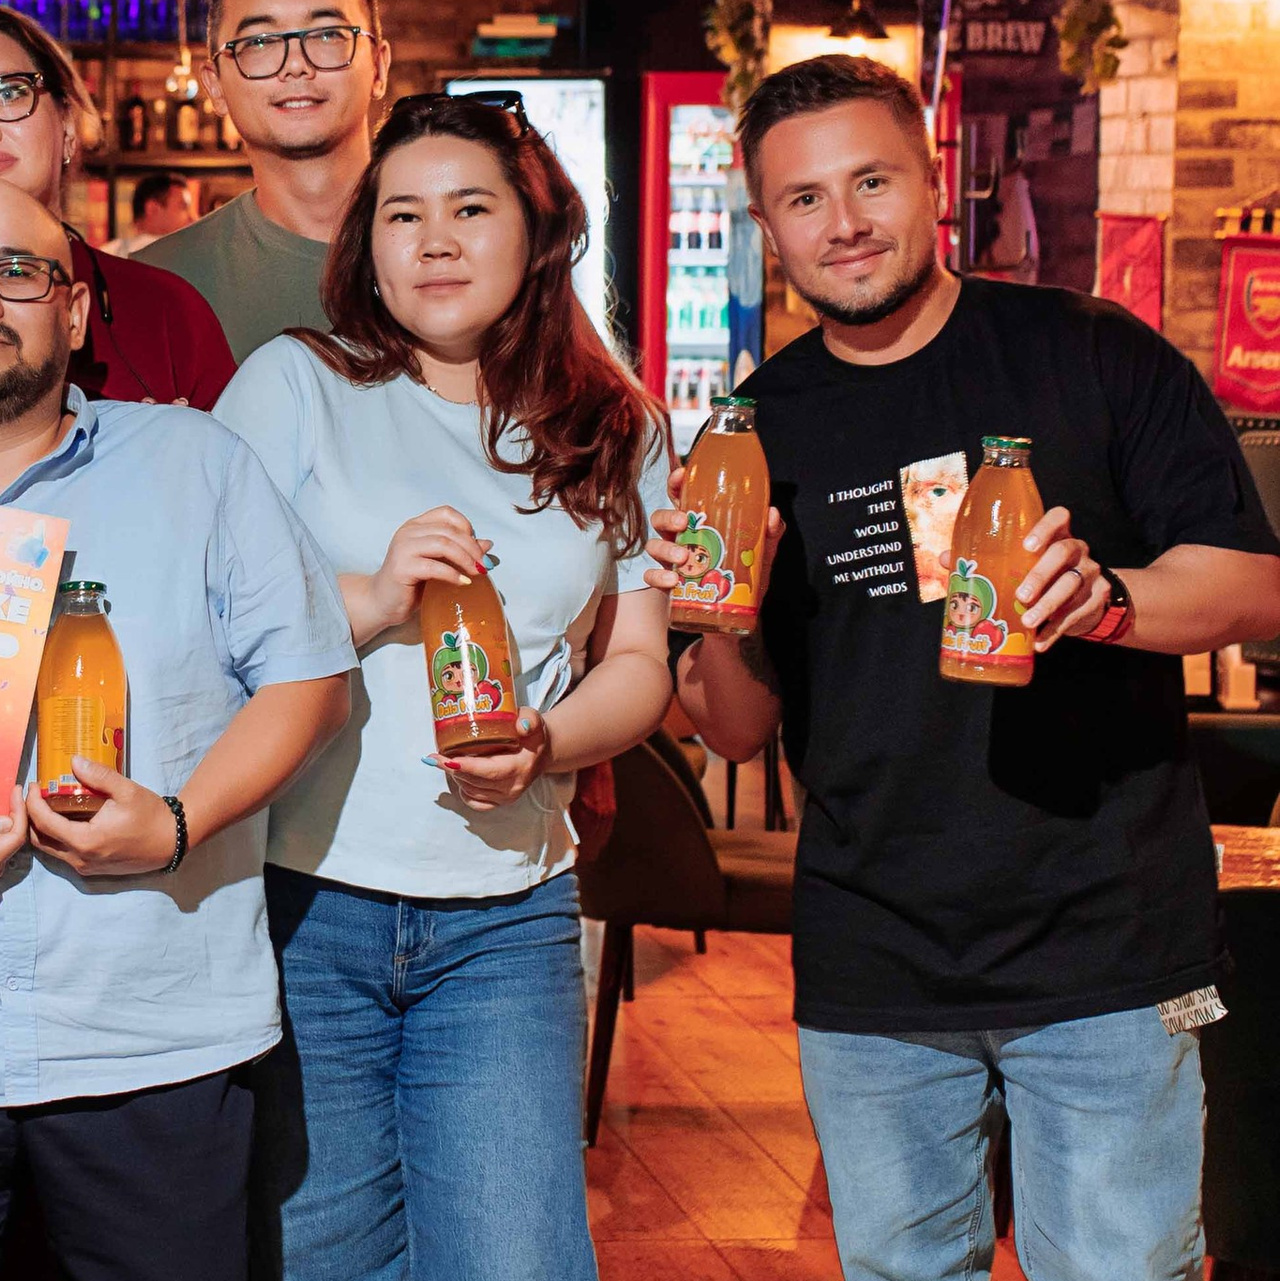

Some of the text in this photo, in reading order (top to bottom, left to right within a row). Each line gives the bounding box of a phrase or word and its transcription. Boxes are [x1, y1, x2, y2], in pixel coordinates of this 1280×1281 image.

[837, 480, 894, 502] THOUGHT
[868, 500, 897, 515] THEY
[854, 521, 899, 538] WOULD
[827, 541, 902, 565] UNDERSTAND
[834, 561, 905, 584] ME WITHOUT
[869, 581, 908, 598] WORDS
